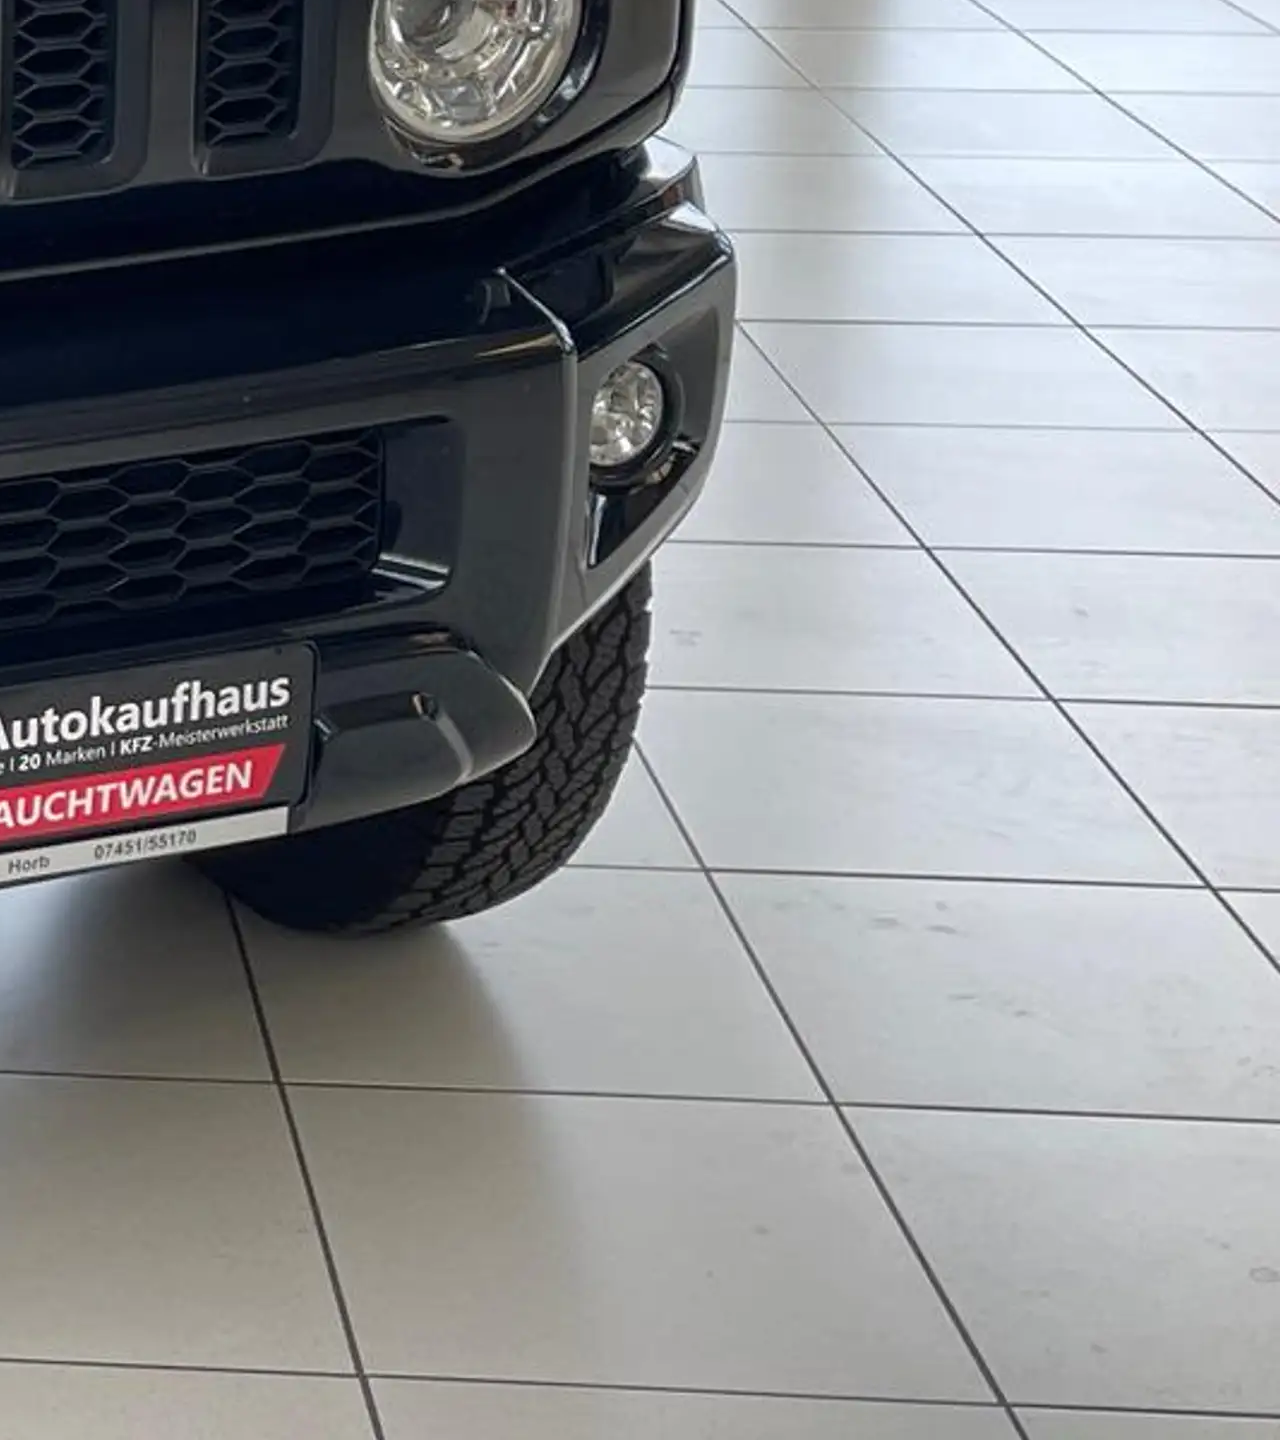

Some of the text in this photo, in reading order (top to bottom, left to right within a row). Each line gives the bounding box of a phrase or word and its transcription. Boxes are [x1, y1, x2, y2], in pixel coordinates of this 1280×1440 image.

[18, 753, 41, 772] 20
[46, 744, 106, 766] Marken
[120, 713, 289, 756] KFZ-Meisterwerkstatt
[8, 855, 51, 875] Horb
[94, 828, 197, 860] 07451/55170
